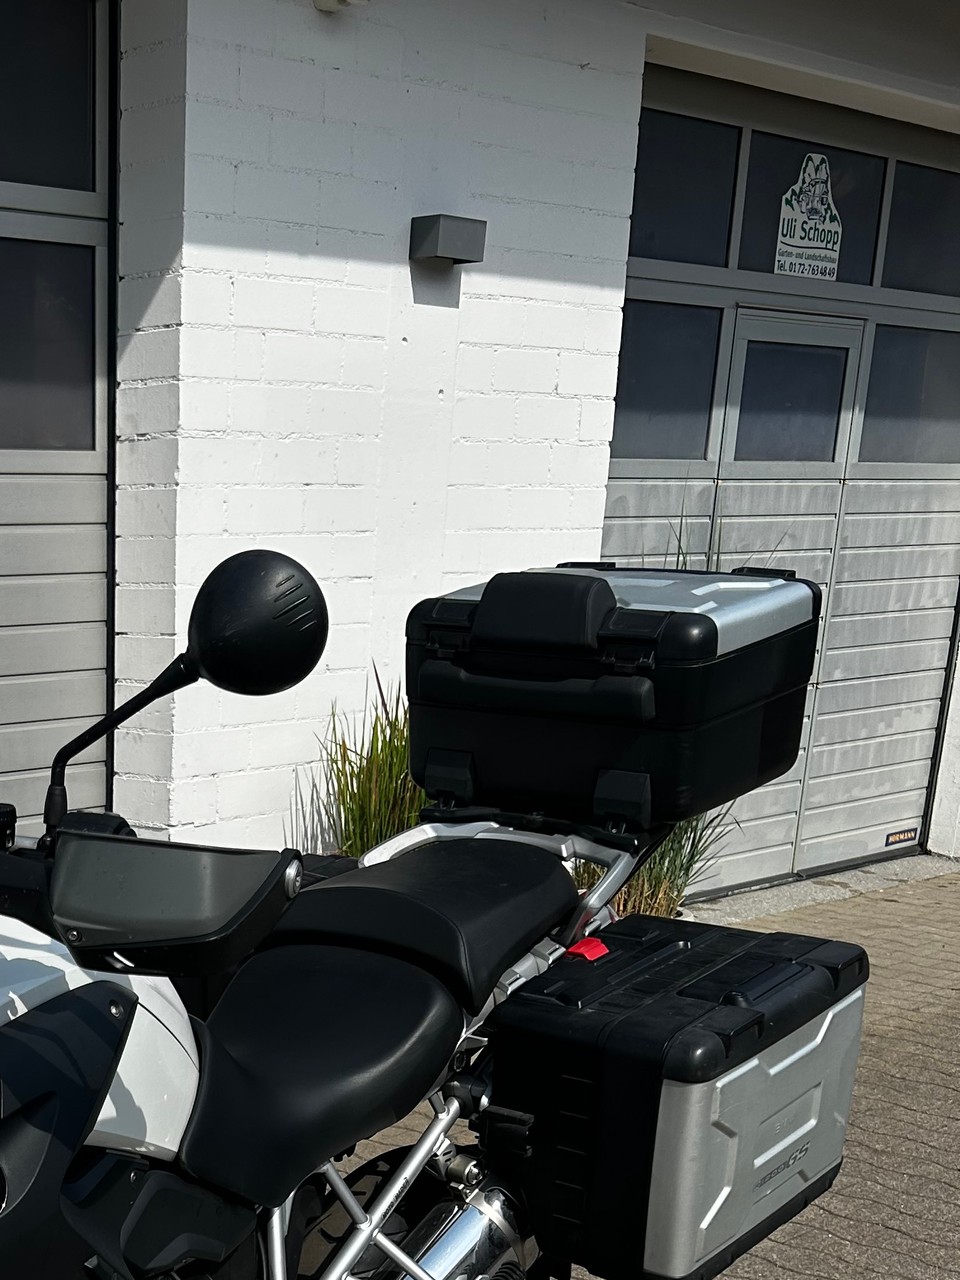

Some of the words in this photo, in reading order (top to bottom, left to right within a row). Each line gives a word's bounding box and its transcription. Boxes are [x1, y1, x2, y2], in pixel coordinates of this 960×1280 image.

[781, 217, 797, 239] Uli
[799, 220, 839, 250] Schopp
[777, 260, 788, 272] Tel.
